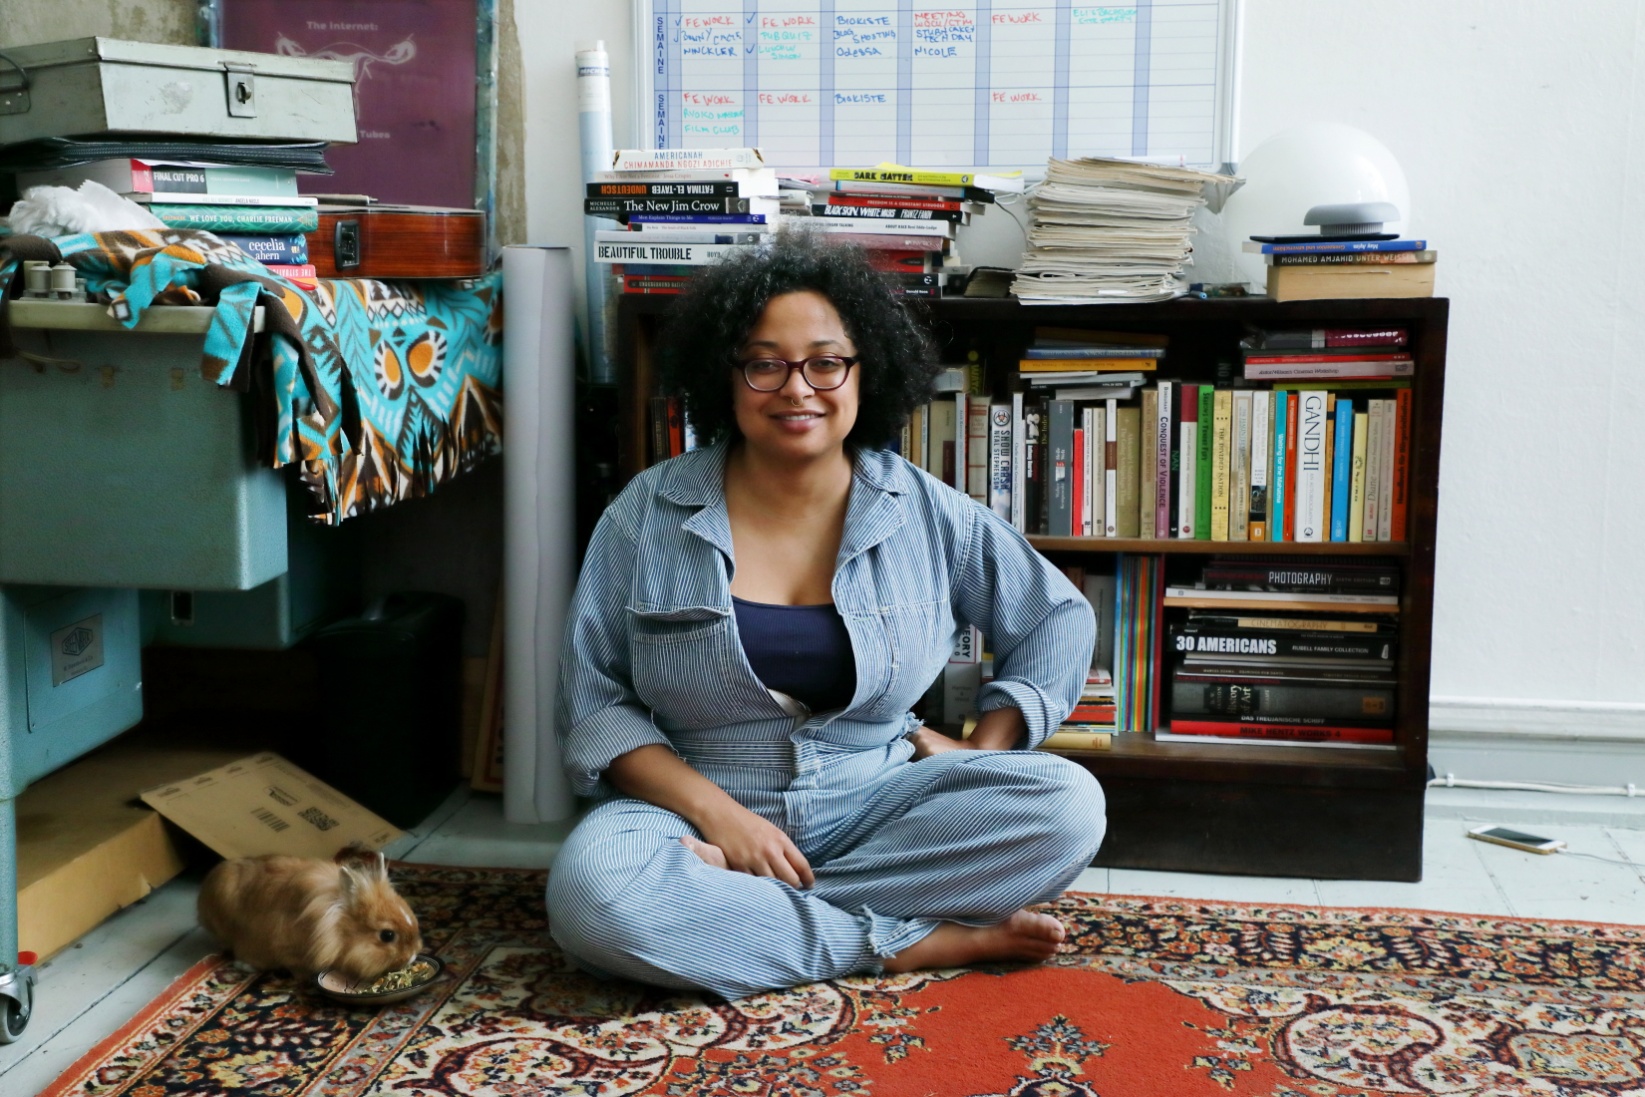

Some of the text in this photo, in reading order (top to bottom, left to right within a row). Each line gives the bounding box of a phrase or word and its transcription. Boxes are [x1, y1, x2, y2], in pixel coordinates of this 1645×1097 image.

[686, 15, 734, 28] FE WORK
[762, 15, 815, 28] FE WORK
[836, 15, 891, 26] BIOKISTE
[992, 12, 1042, 24] FE WORK
[306, 21, 378, 31] The Internet:
[760, 31, 780, 41] PUB
[951, 33, 973, 42] DAY
[657, 16, 665, 75] SEMAINE
[836, 47, 882, 58] Odessa
[914, 46, 958, 58] NICOLE
[683, 93, 736, 106] FE WORK
[759, 94, 812, 104] FE WORK
[1010, 92, 1042, 103] WORK
[684, 124, 740, 136] FILM CLUB
[654, 151, 703, 160] AMERICANAH
[623, 159, 732, 170] CHIMAMANDA NGOZI ADICHIE
[153, 171, 171, 182] FINAL
[173, 172, 184, 182] CUT
[186, 173, 198, 183] PRO
[199, 174, 205, 183] 6
[854, 171, 877, 180] DARK
[601, 185, 647, 194] UNDEUTSCH
[652, 184, 714, 194] FATIMA EL-TAYEB
[624, 200, 720, 213] The New Jim Crow
[824, 204, 841, 215] BLACK
[860, 207, 880, 217] WHITE
[220, 215, 235, 223] YOU,
[236, 215, 262, 223] CHARLIE
[248, 237, 285, 251] cecelia
[255, 251, 280, 260] ahern
[598, 246, 692, 260] BEAUTIFUL TROUBLE
[1281, 255, 1318, 264] MOHAMED
[1320, 255, 1354, 263] AMJAHID
[1356, 254, 1381, 262] UNTER
[301, 269, 311, 277] THE
[1303, 395, 1322, 471] GANDHI
[1276, 433, 1284, 456] Waiting
[1000, 430, 1010, 490] SNOW CRASH
[1158, 416, 1169, 508] CONQUEST OF VIOLENCE
[1171, 450, 1179, 471] NAN
[1367, 476, 1377, 501] Diane
[1268, 571, 1333, 585] PHOTOGRAPHY
[1250, 619, 1327, 629] CINEMATOGRAPHY
[1176, 635, 1277, 655] 30 AMERICANS
[1334, 646, 1369, 654] COLLECTION
[1226, 684, 1242, 714] History
[1241, 686, 1251, 703] Art
[1240, 727, 1263, 735] MIKE
[1266, 728, 1295, 736] HENTZ
